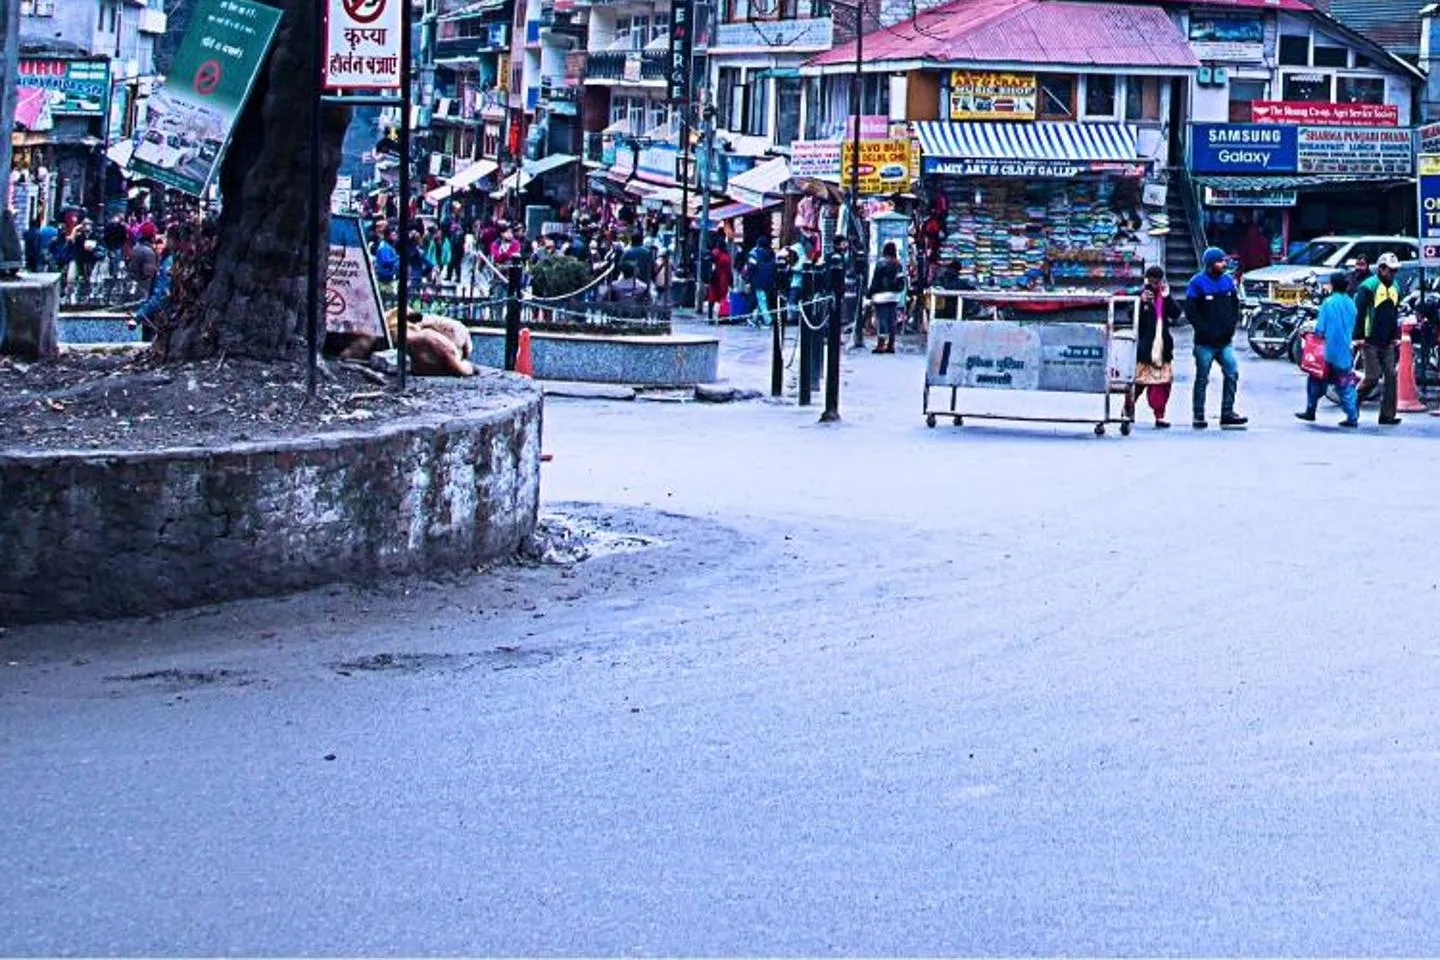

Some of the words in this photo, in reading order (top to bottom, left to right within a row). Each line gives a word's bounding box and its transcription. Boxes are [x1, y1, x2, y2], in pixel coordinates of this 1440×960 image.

[1208, 129, 1281, 143] SAMSUNG
[846, 143, 880, 152] VLVO
[1218, 149, 1271, 168] Galaxy
[965, 163, 988, 174] ART
[1000, 163, 1036, 176] CRAFT
